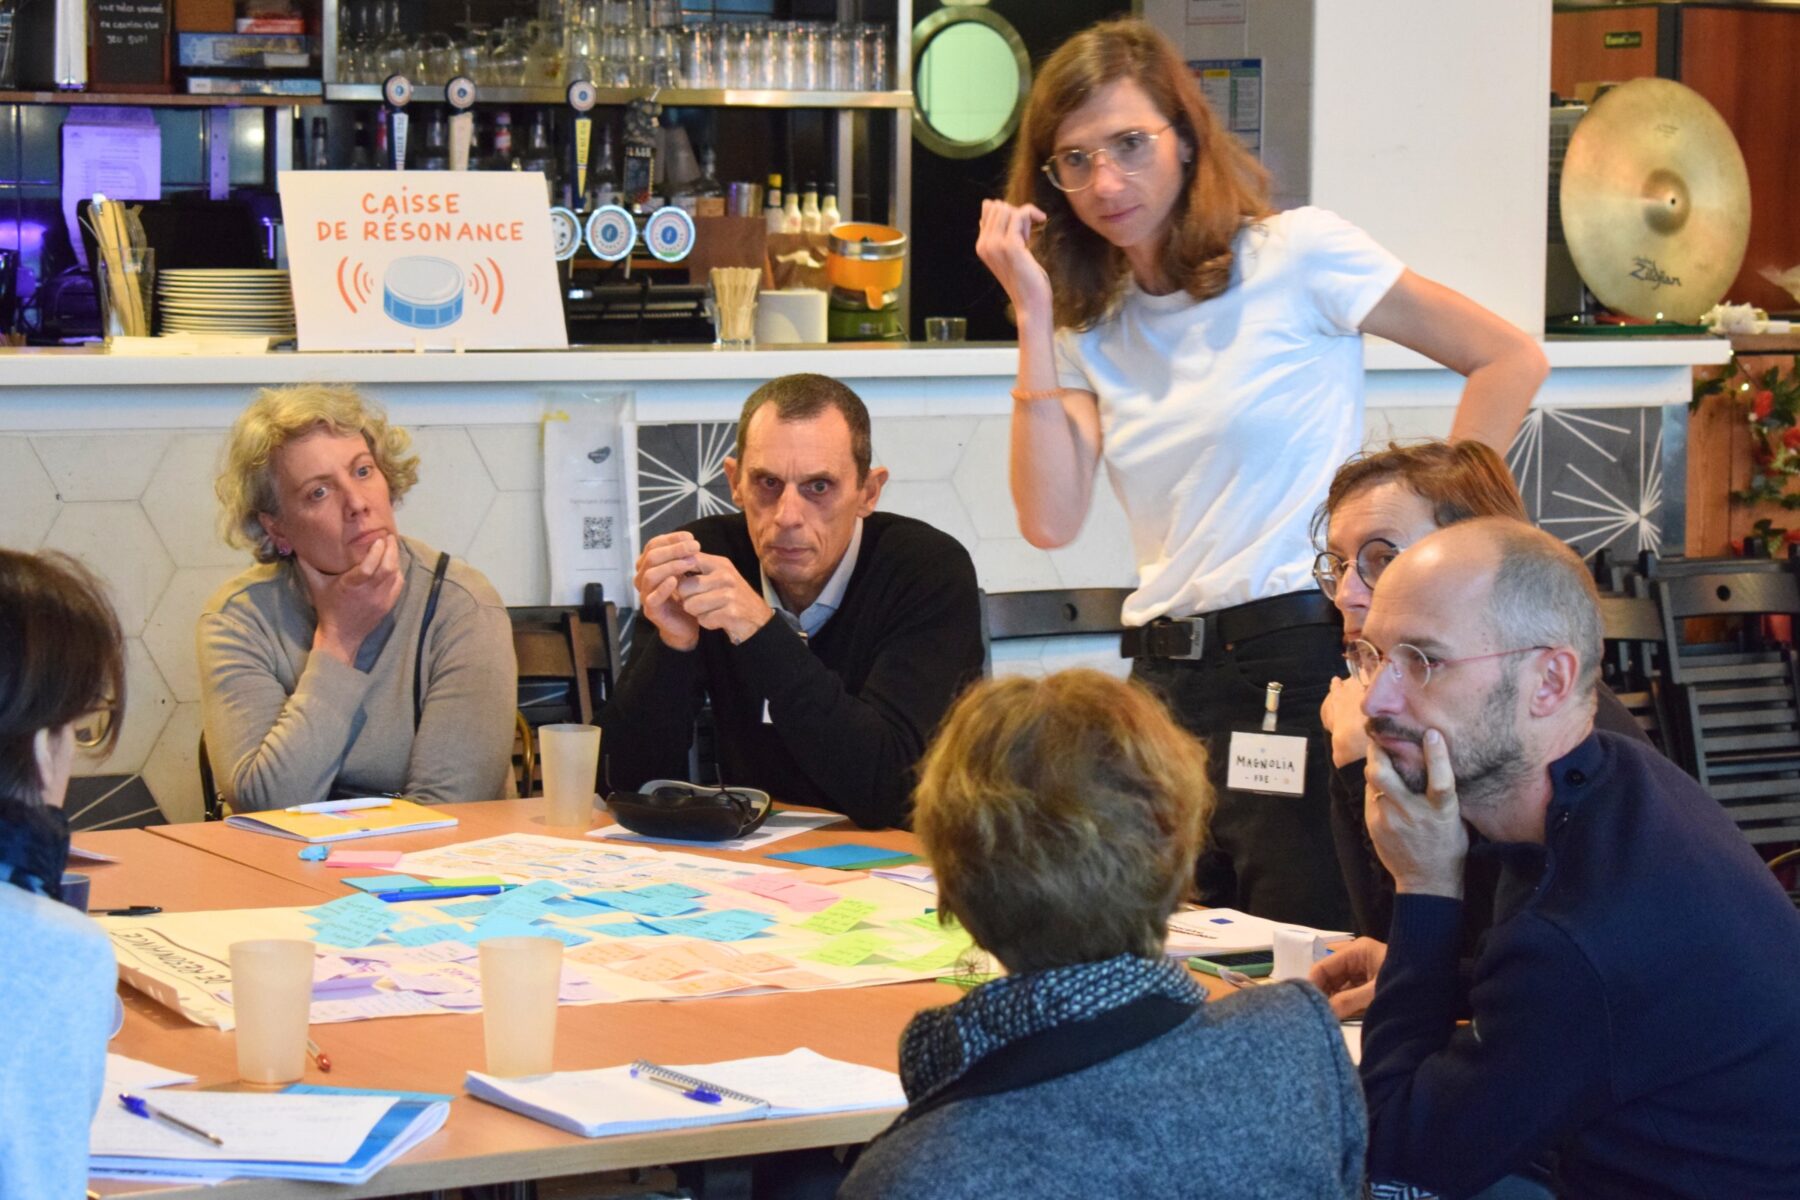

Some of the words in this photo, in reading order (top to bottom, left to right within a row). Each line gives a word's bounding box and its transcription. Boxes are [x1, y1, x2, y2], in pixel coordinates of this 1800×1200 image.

[317, 221, 348, 241] DE
[363, 213, 524, 242] RÉSONANCE
[1236, 755, 1295, 772] MAGNOLIA
